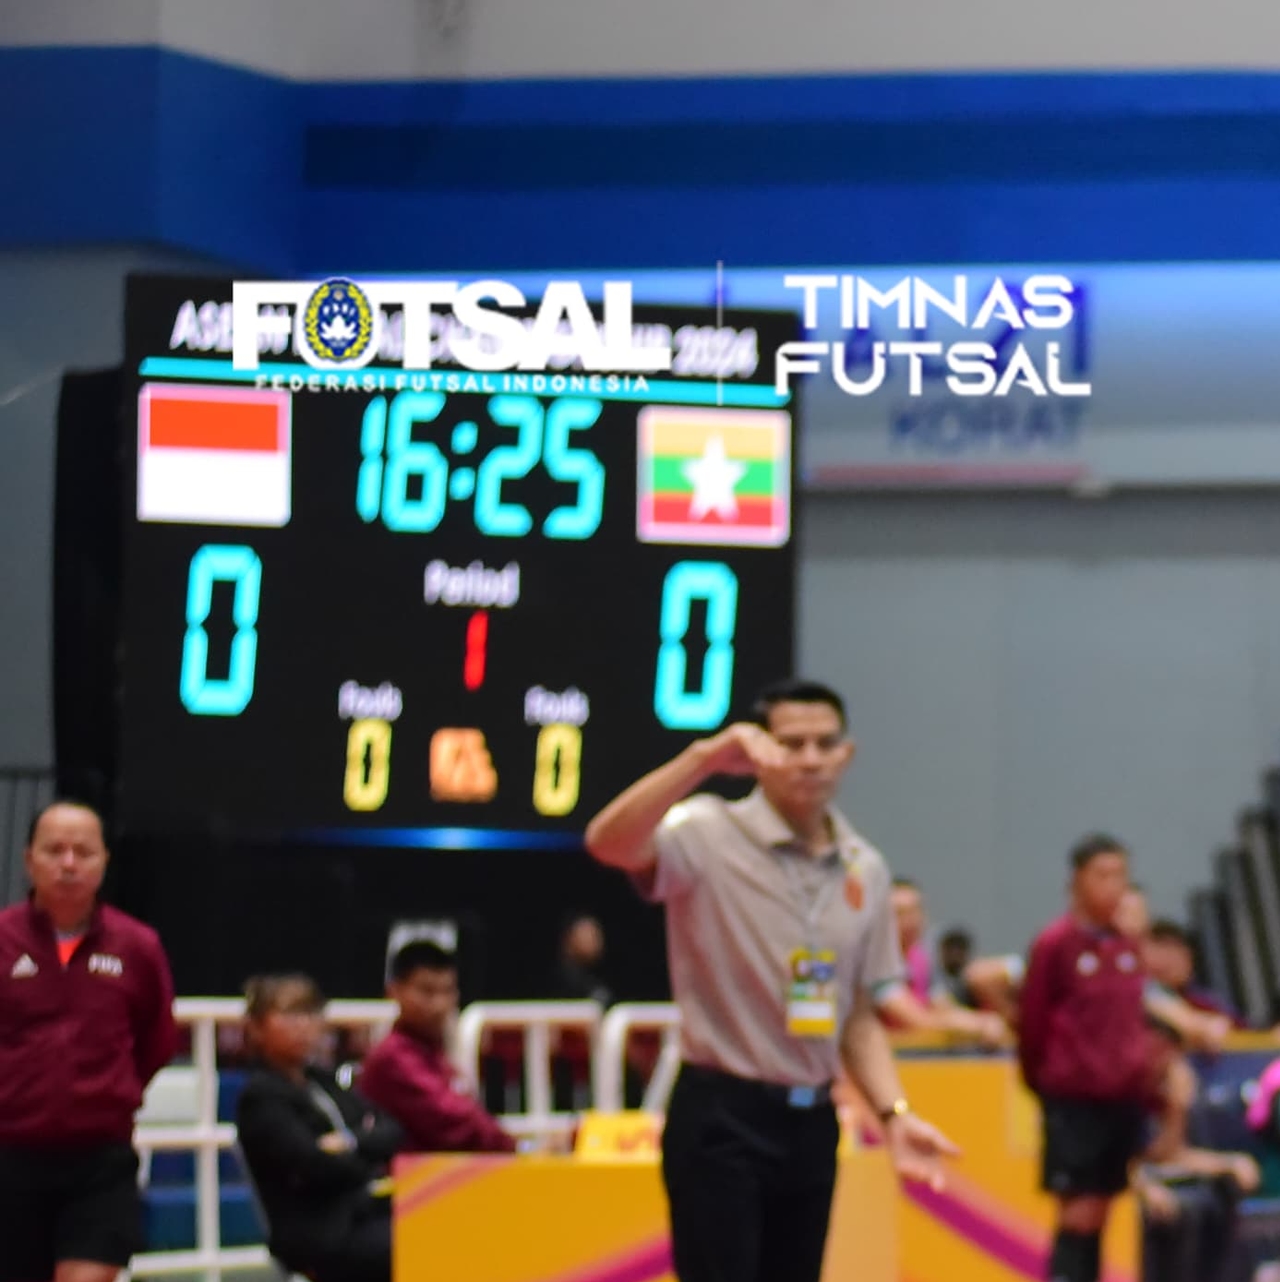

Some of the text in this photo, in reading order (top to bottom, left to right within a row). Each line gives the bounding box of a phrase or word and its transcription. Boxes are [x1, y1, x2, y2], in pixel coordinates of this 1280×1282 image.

[355, 394, 606, 540] 16:25
[179, 544, 263, 716] 0
[463, 608, 488, 692] 1
[654, 561, 739, 730] 0
[343, 717, 392, 812] 0
[532, 722, 583, 817] 0
